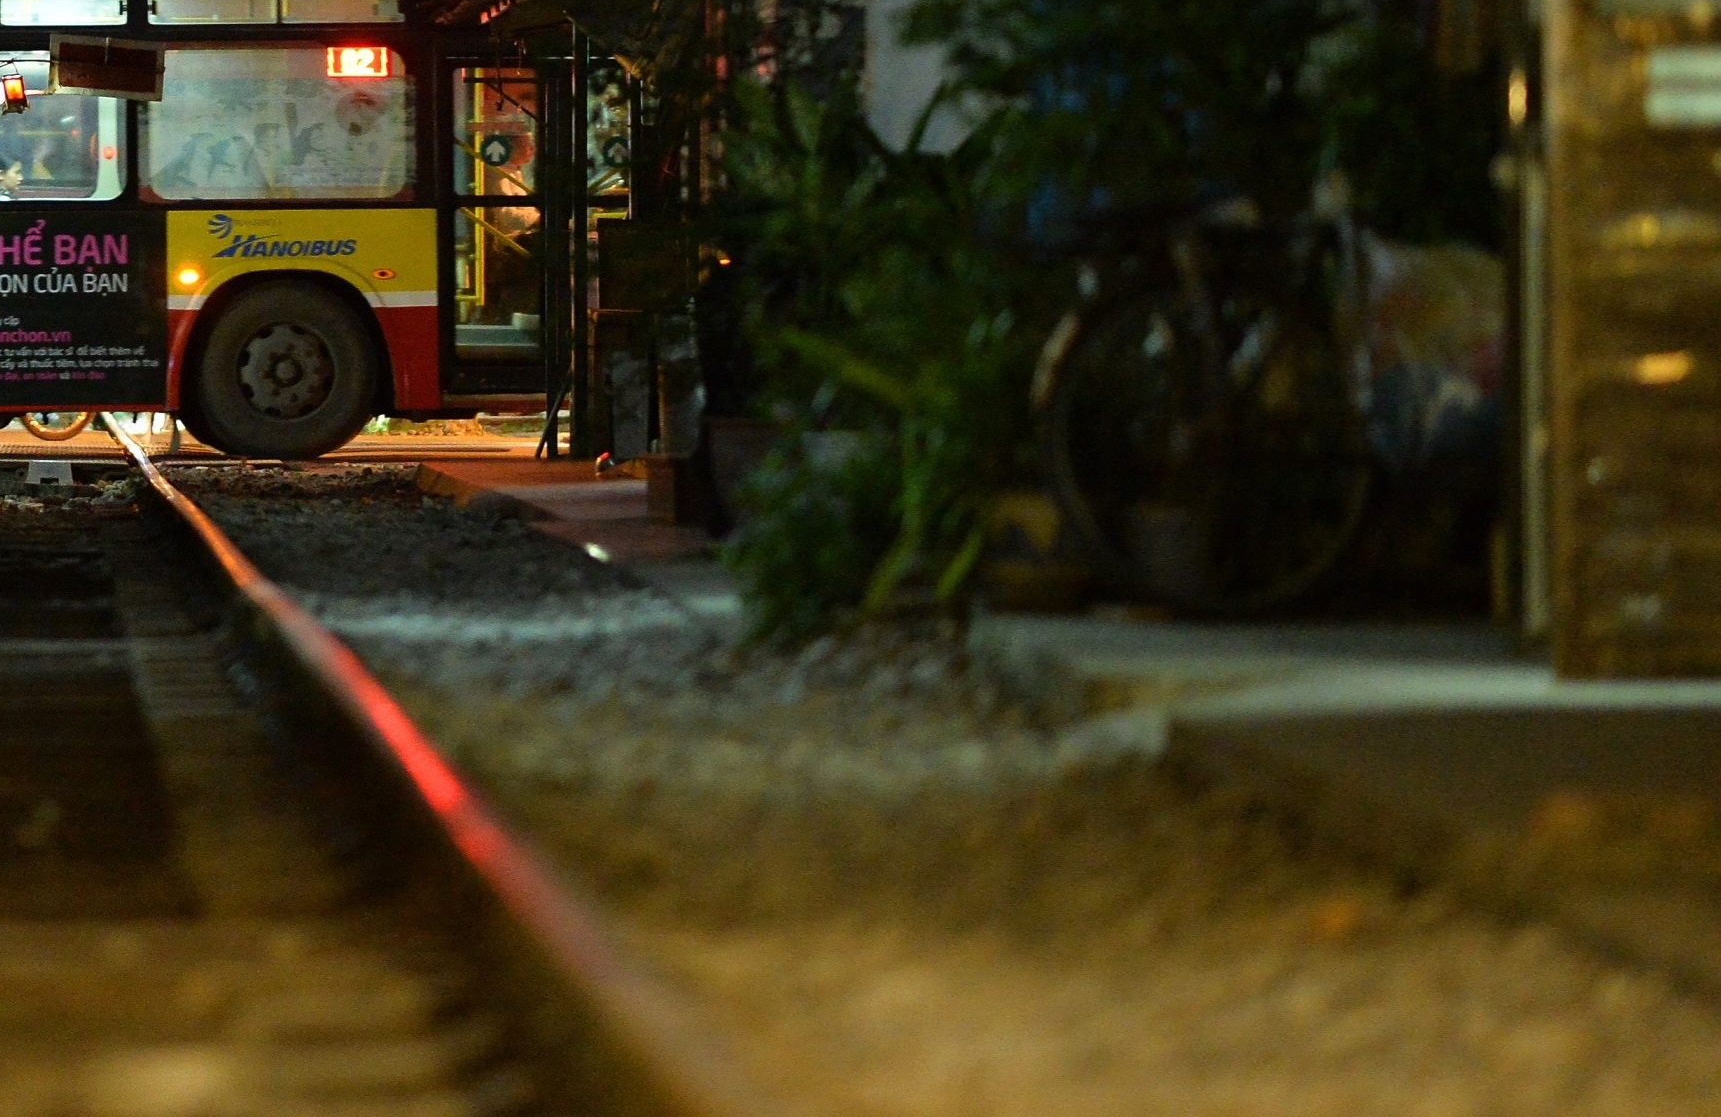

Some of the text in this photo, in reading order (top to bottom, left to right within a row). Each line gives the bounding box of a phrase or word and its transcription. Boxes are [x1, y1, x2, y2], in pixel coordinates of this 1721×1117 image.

[54, 234, 129, 272] BẠN
[33, 267, 77, 294] CỦA
[82, 273, 128, 296] BẠN
